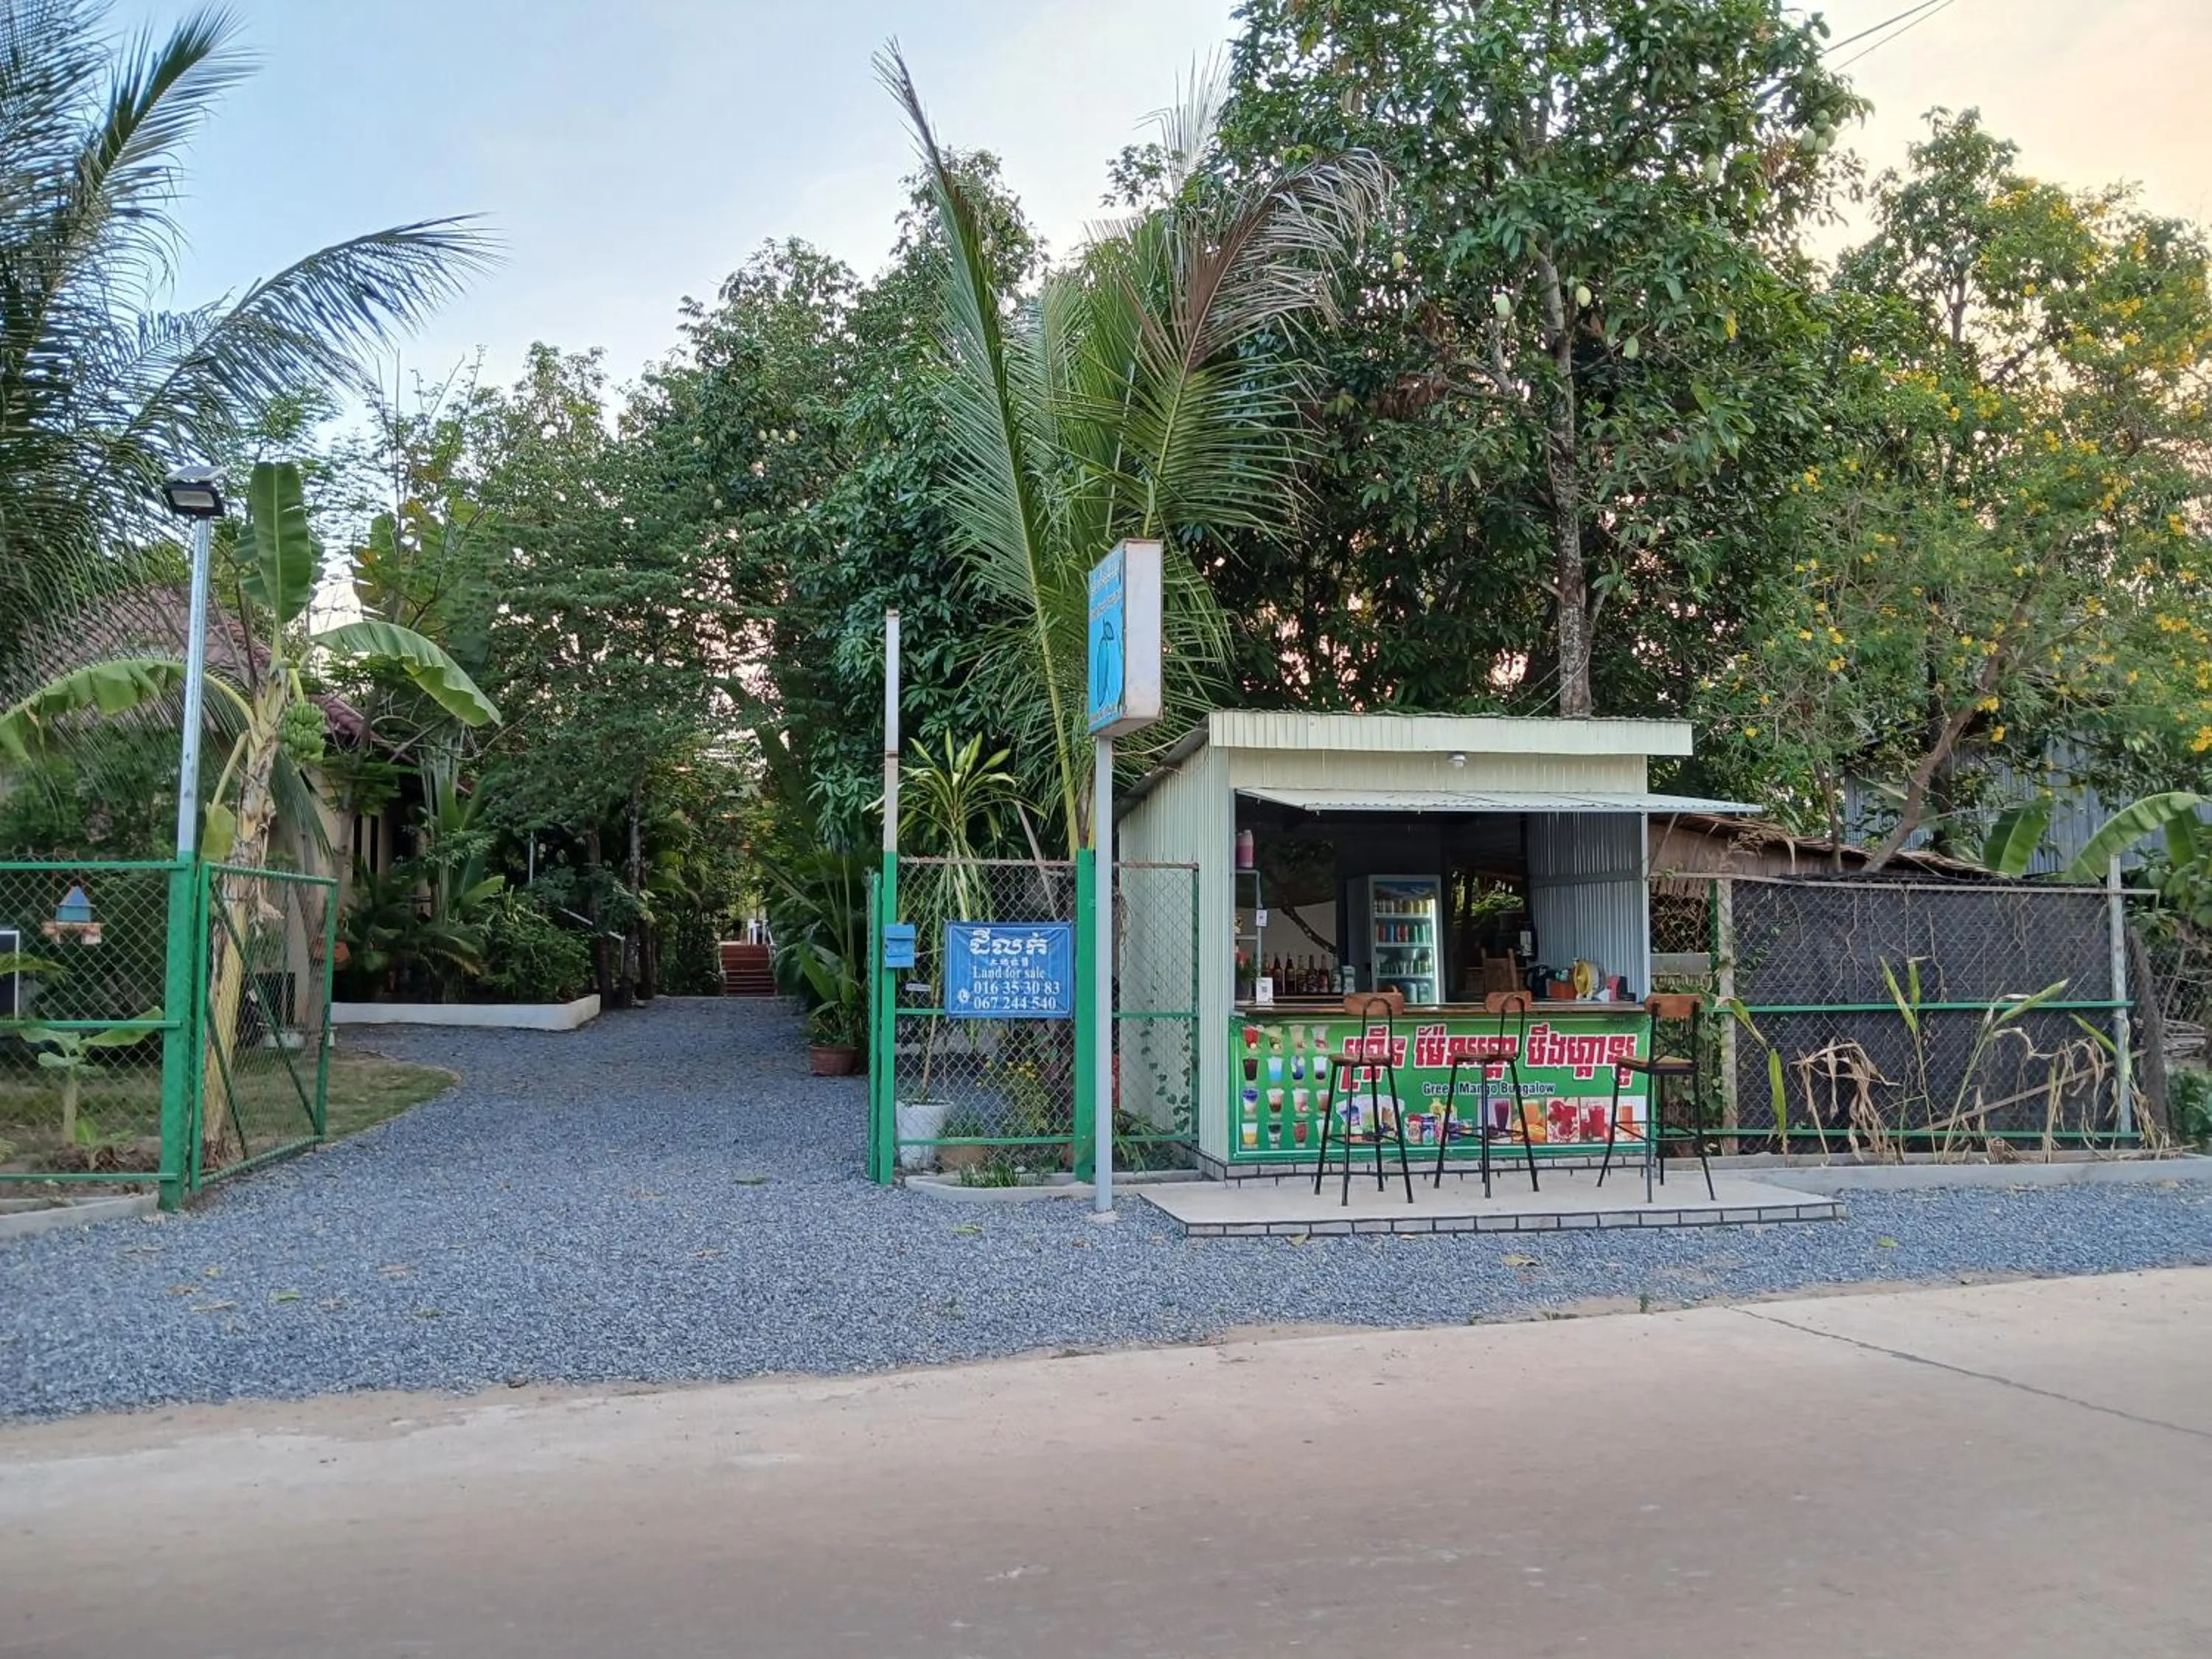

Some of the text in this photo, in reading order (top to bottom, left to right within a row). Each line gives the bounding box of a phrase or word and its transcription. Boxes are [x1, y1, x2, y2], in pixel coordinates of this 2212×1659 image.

[973, 966, 1045, 978] Land for sale
[973, 981, 1060, 995] 016 35 30 83
[973, 997, 1056, 1009] 067 244 540
[1424, 1082, 1455, 1094] Gree
[1500, 1082, 1556, 1096] Bugalow
